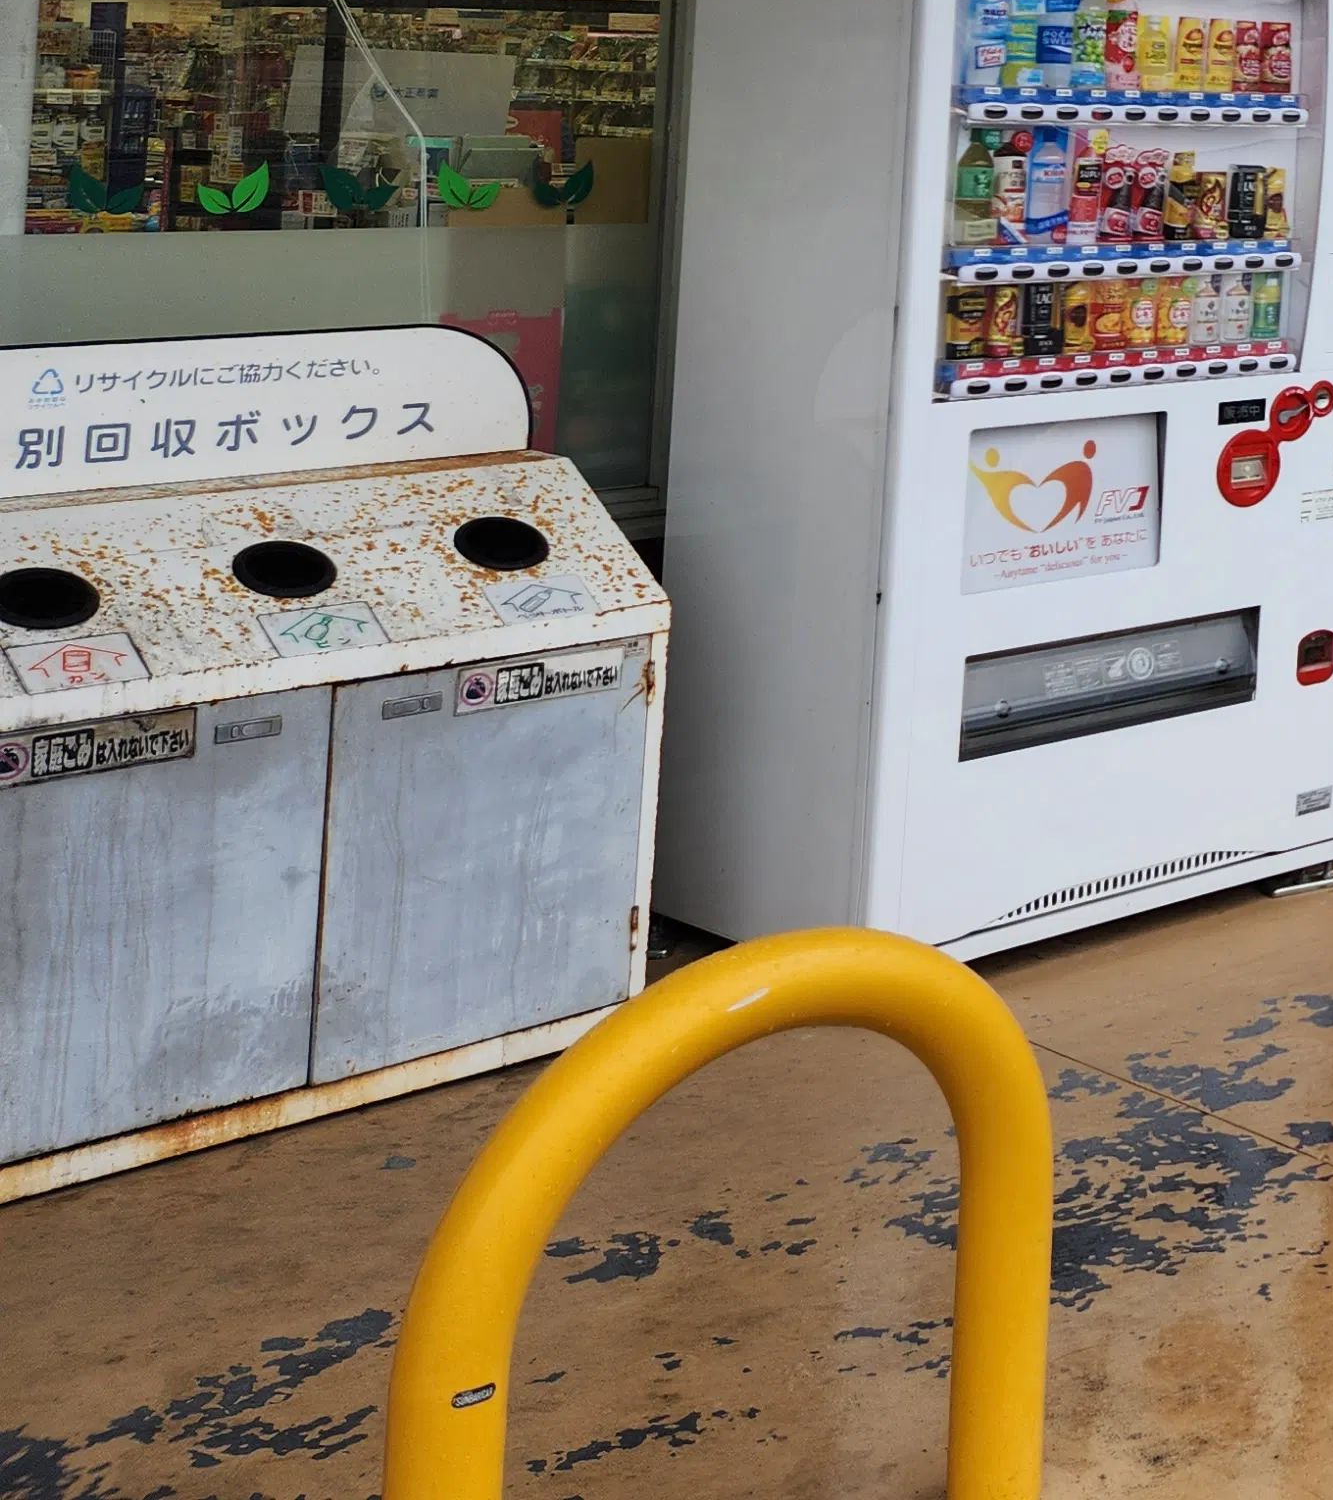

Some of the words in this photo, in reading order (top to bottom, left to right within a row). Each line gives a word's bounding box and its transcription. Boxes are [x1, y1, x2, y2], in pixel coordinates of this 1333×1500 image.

[74, 358, 381, 395] リサイクルにご協力ください。
[15, 402, 435, 470] 別回収ボックス
[1095, 485, 1150, 516] FVJ
[316, 637, 352, 649] ビン
[68, 671, 106, 684] カン
